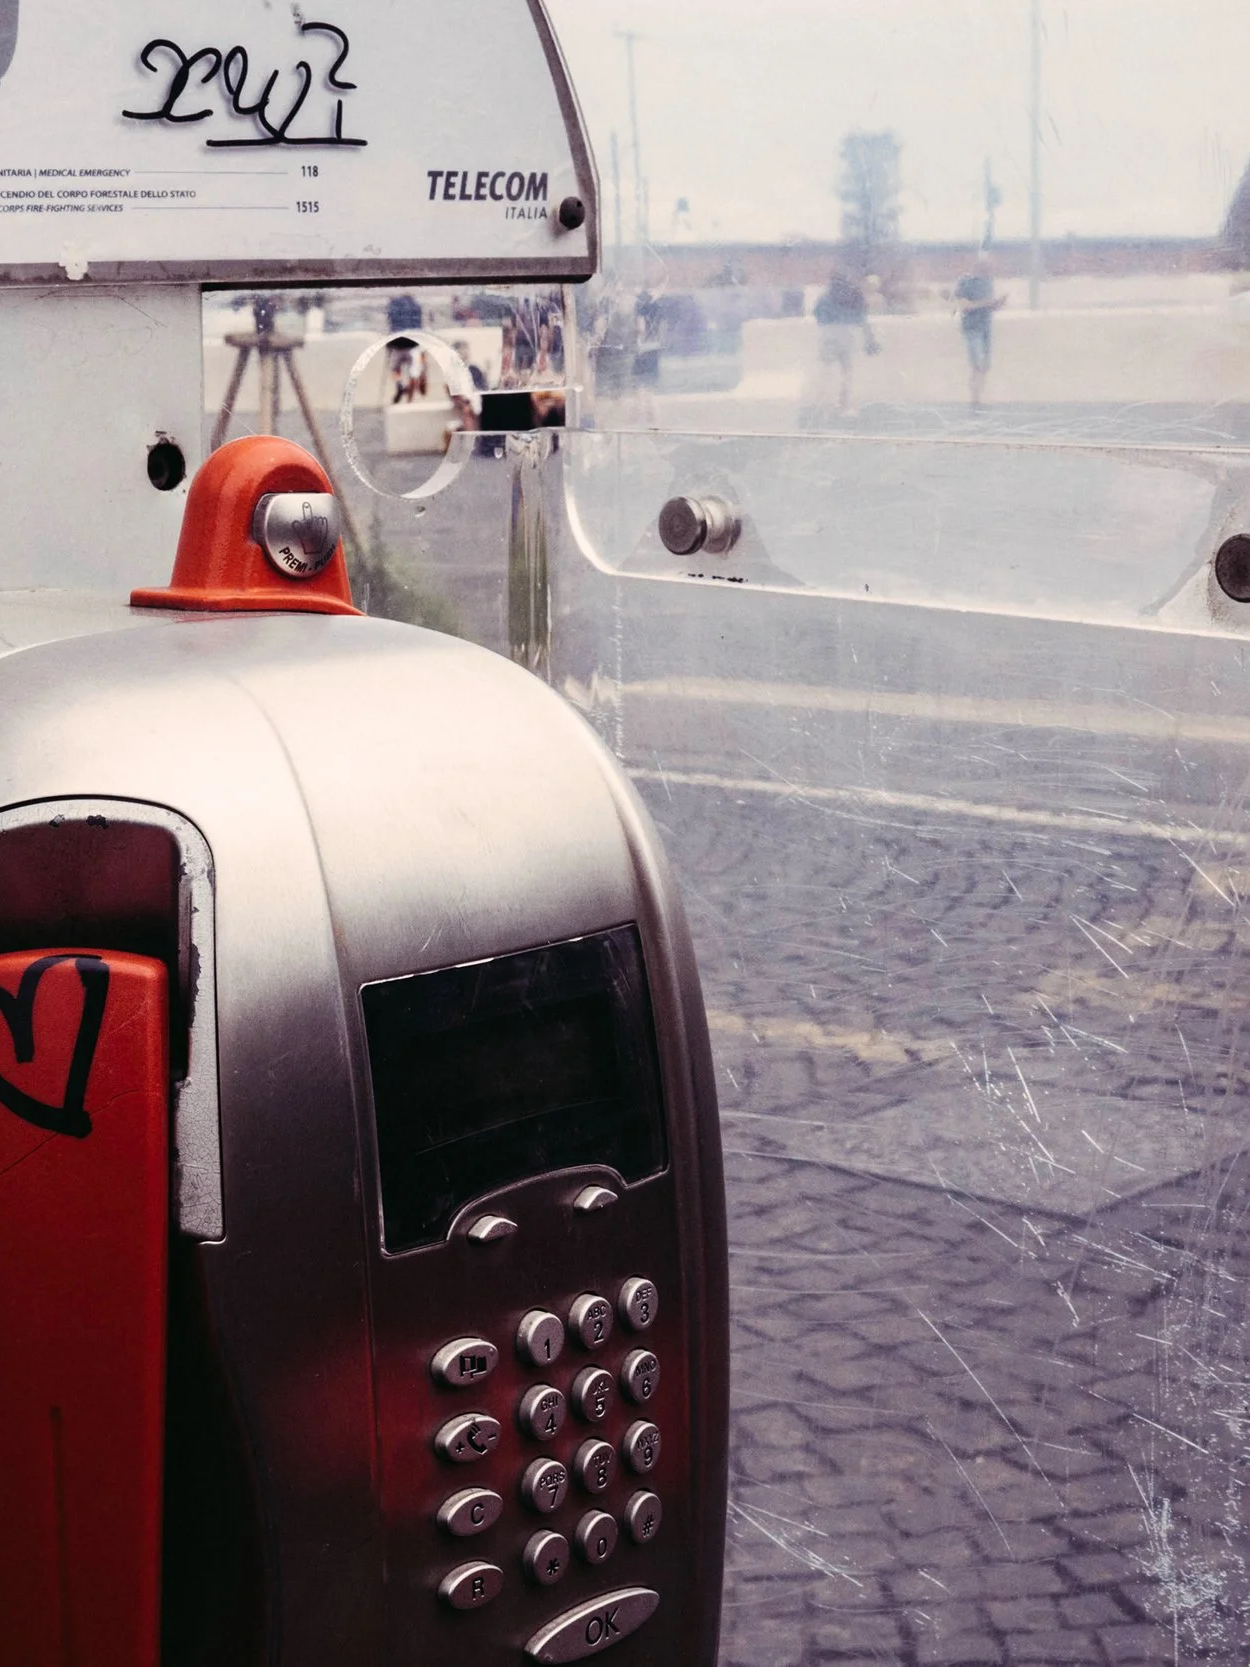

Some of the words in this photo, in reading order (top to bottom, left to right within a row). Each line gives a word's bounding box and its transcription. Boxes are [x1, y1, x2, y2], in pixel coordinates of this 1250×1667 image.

[38, 169, 76, 177] MEDICAL
[79, 169, 131, 177] EMERGENCY
[301, 165, 319, 177] 118
[56, 190, 88, 198] CORPO
[90, 190, 138, 198] FORESTALE
[140, 190, 168, 198] DELLO
[170, 190, 196, 198] STATO
[427, 171, 548, 201] TELECOM
[26, 204, 85, 212] FIRE-FIGHTING
[296, 201, 319, 213] 1515
[505, 207, 548, 220] ITALIA
[279, 546, 308, 573] PREMI
[635, 1287, 652, 1303] DEF
[588, 1305, 607, 1320] ABC
[640, 1303, 650, 1325] 3
[594, 1321, 604, 1343] 2
[544, 1338, 551, 1360] 1
[635, 1359, 657, 1377] MNO
[642, 1378, 651, 1400] 6
[541, 1396, 559, 1412] GHI
[595, 1397, 606, 1418] 5
[545, 1413, 557, 1435] 4
[644, 1446, 653, 1468] 9
[540, 1471, 565, 1490] PQRS
[598, 1468, 607, 1489] 8
[549, 1484, 559, 1508] 7
[470, 1502, 485, 1527] C
[472, 1577, 485, 1601] R
[584, 1607, 621, 1646] OK
